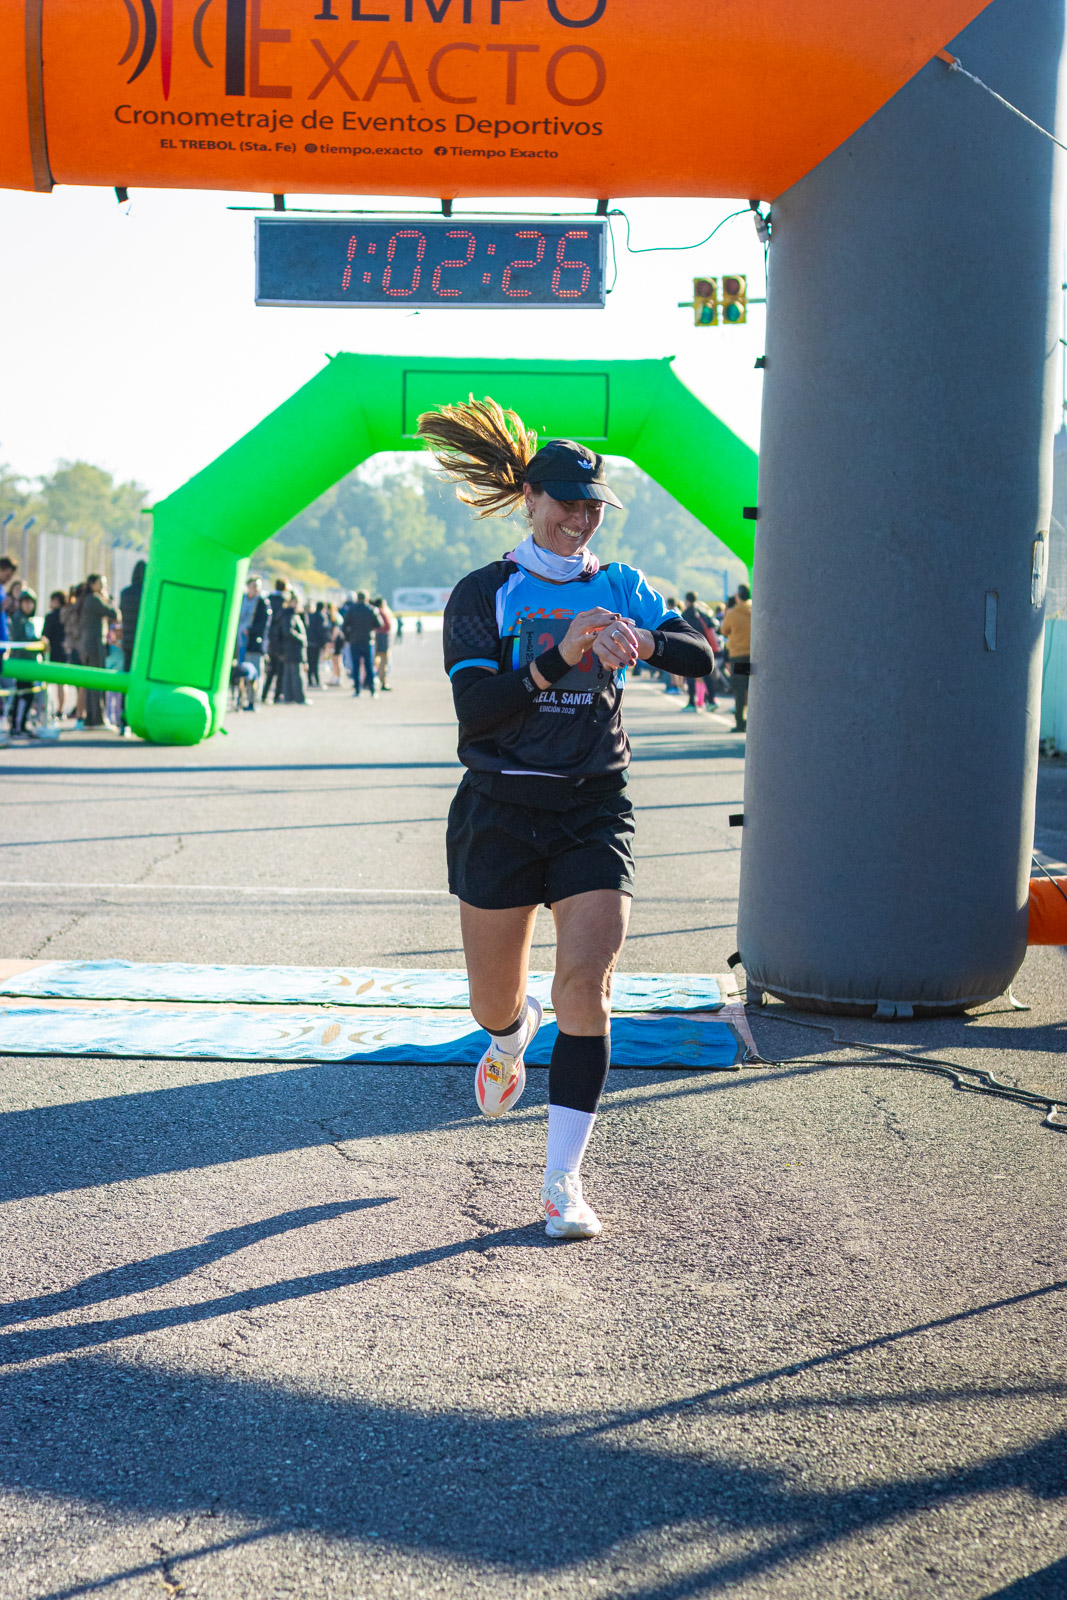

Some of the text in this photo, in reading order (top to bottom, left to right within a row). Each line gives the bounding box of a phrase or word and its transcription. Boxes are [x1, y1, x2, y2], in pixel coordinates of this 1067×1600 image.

[249, 0, 607, 106] EXACTO
[114, 104, 603, 139] Cronometraje de Eventos Deportivos
[160, 138, 559, 159] EL TREBOL (Sta. Fe) tiempo.exacto Tiempo Exacto
[342, 229, 591, 299] 1:02:26
